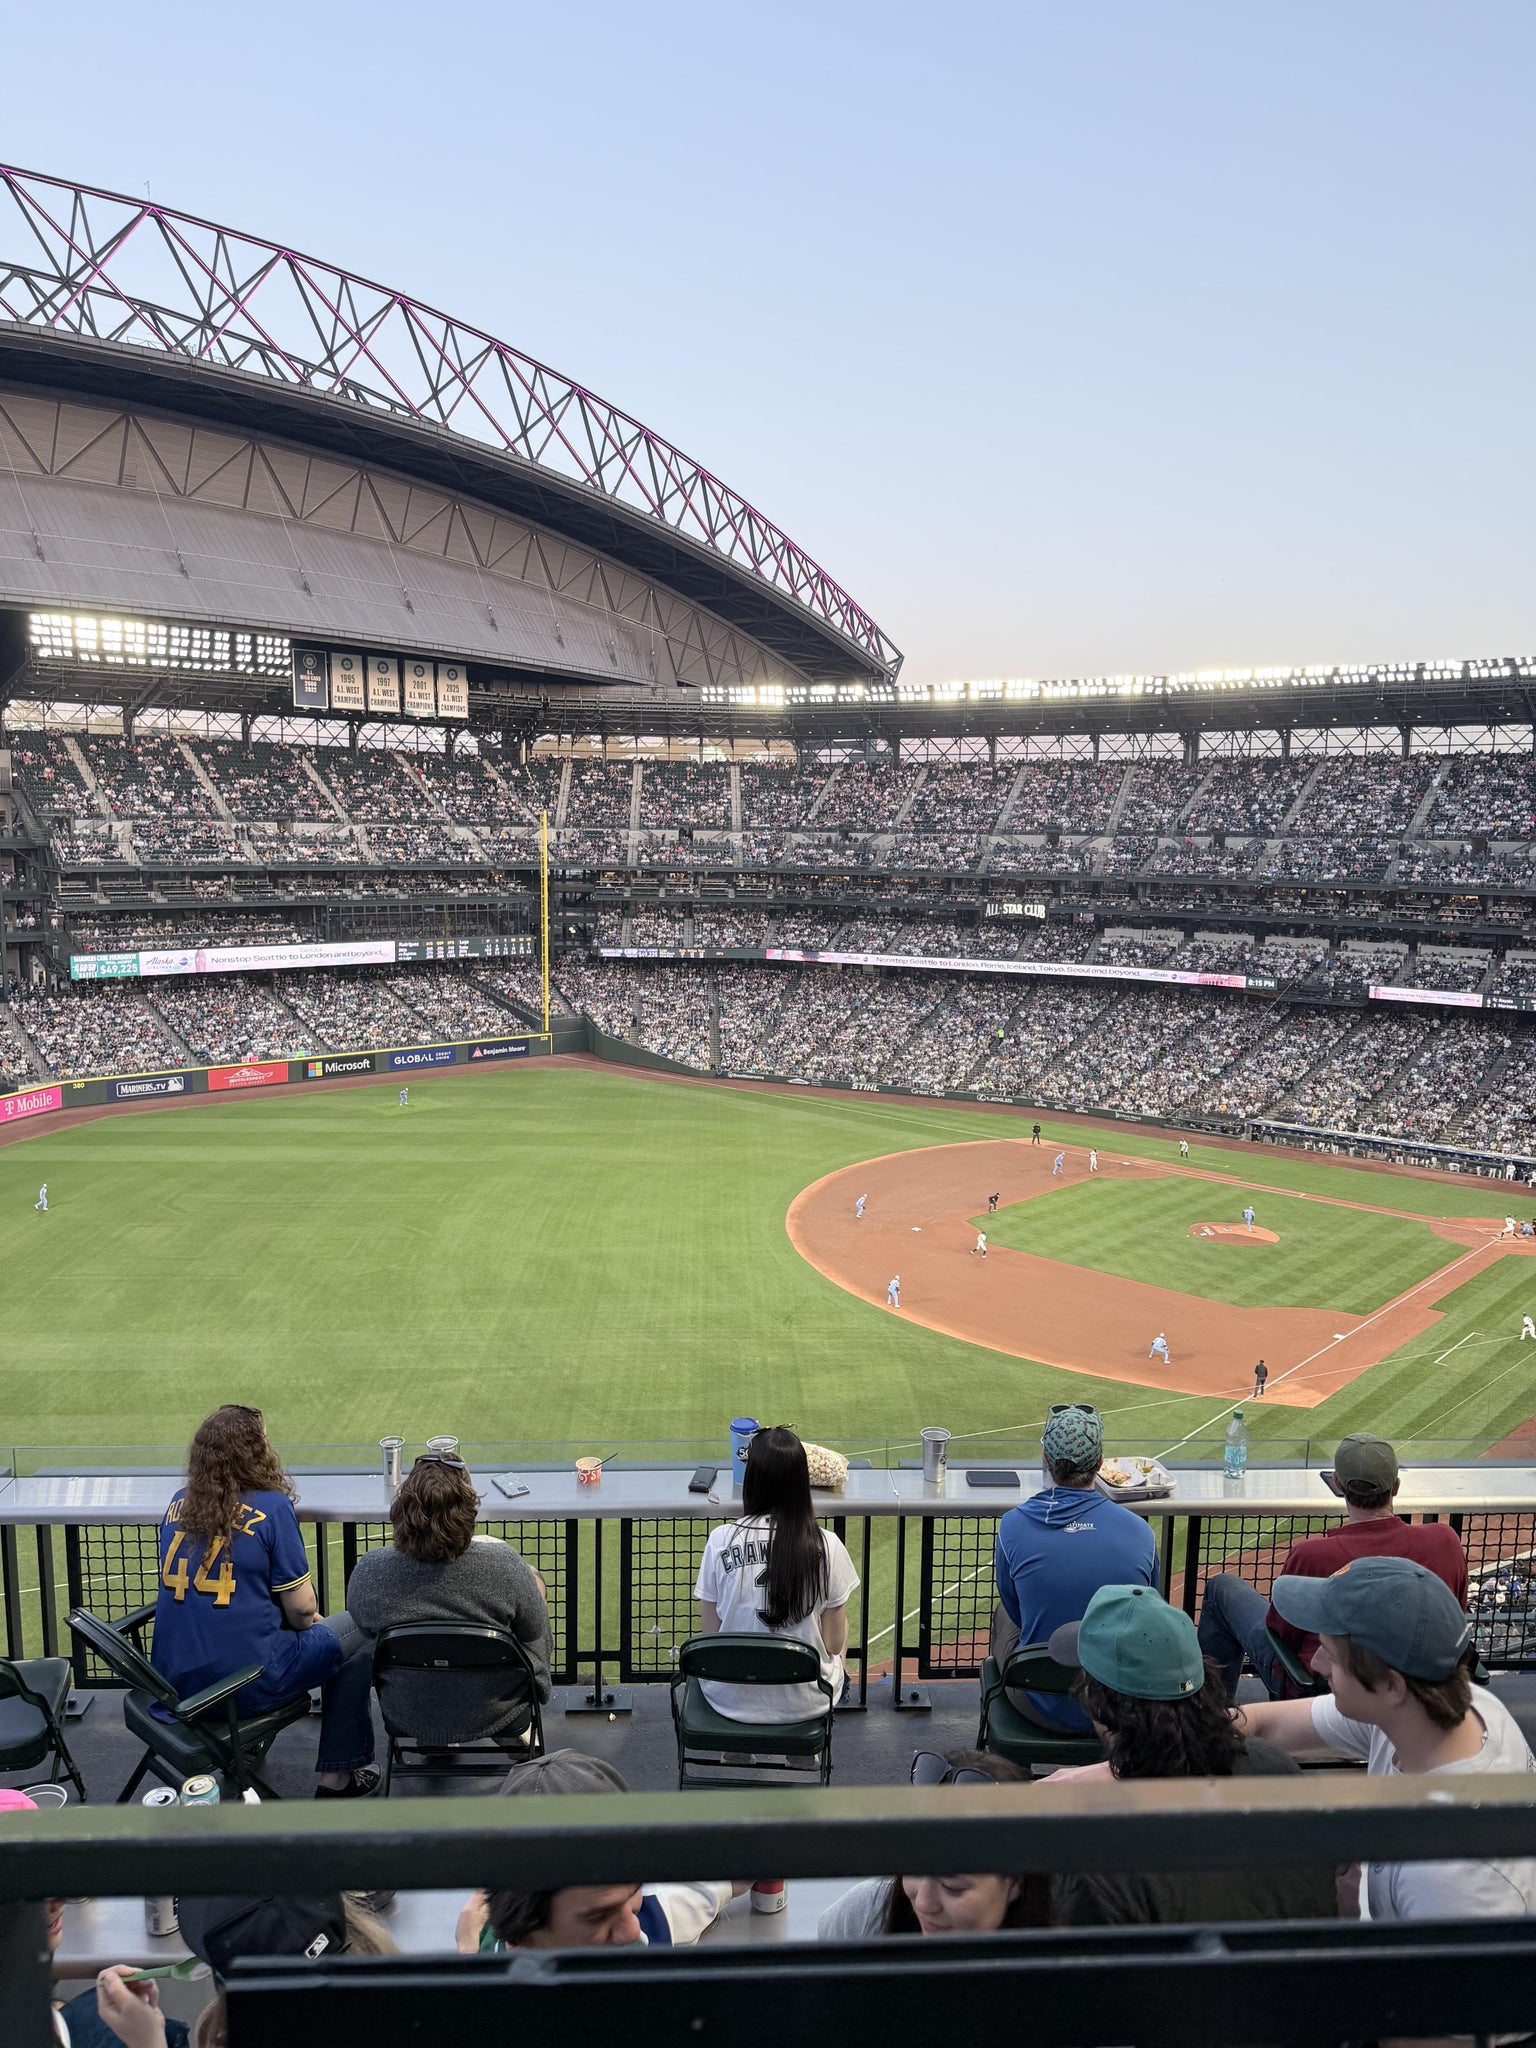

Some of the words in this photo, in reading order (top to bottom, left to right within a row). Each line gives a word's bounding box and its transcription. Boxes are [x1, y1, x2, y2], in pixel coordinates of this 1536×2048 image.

[341, 674, 355, 683] 1995
[377, 677, 390, 686] 1997
[413, 680, 427, 690] 2001
[446, 684, 460, 693] 2025
[382, 689, 395, 697] WEST
[334, 696, 363, 704] CHAMPIONS
[371, 698, 398, 707] CHAMPIONS
[451, 695, 463, 703] WEST
[407, 701, 433, 710] CHAMPIONS
[441, 704, 466, 712] CHAMPIONS
[1024, 904, 1046, 918] CLUB
[145, 957, 174, 965] Alaska
[877, 957, 908, 965] Nonstop
[910, 958, 938, 966] Seattle
[483, 1047, 508, 1056] Benjamin
[394, 1054, 434, 1065] GLOBAL
[325, 1059, 371, 1073] Microsoft
[852, 1083, 879, 1092] STIHL
[930, 1089, 945, 1097] Clips
[17, 1094, 53, 1113] Mobile
[162, 1531, 236, 1607] 44
